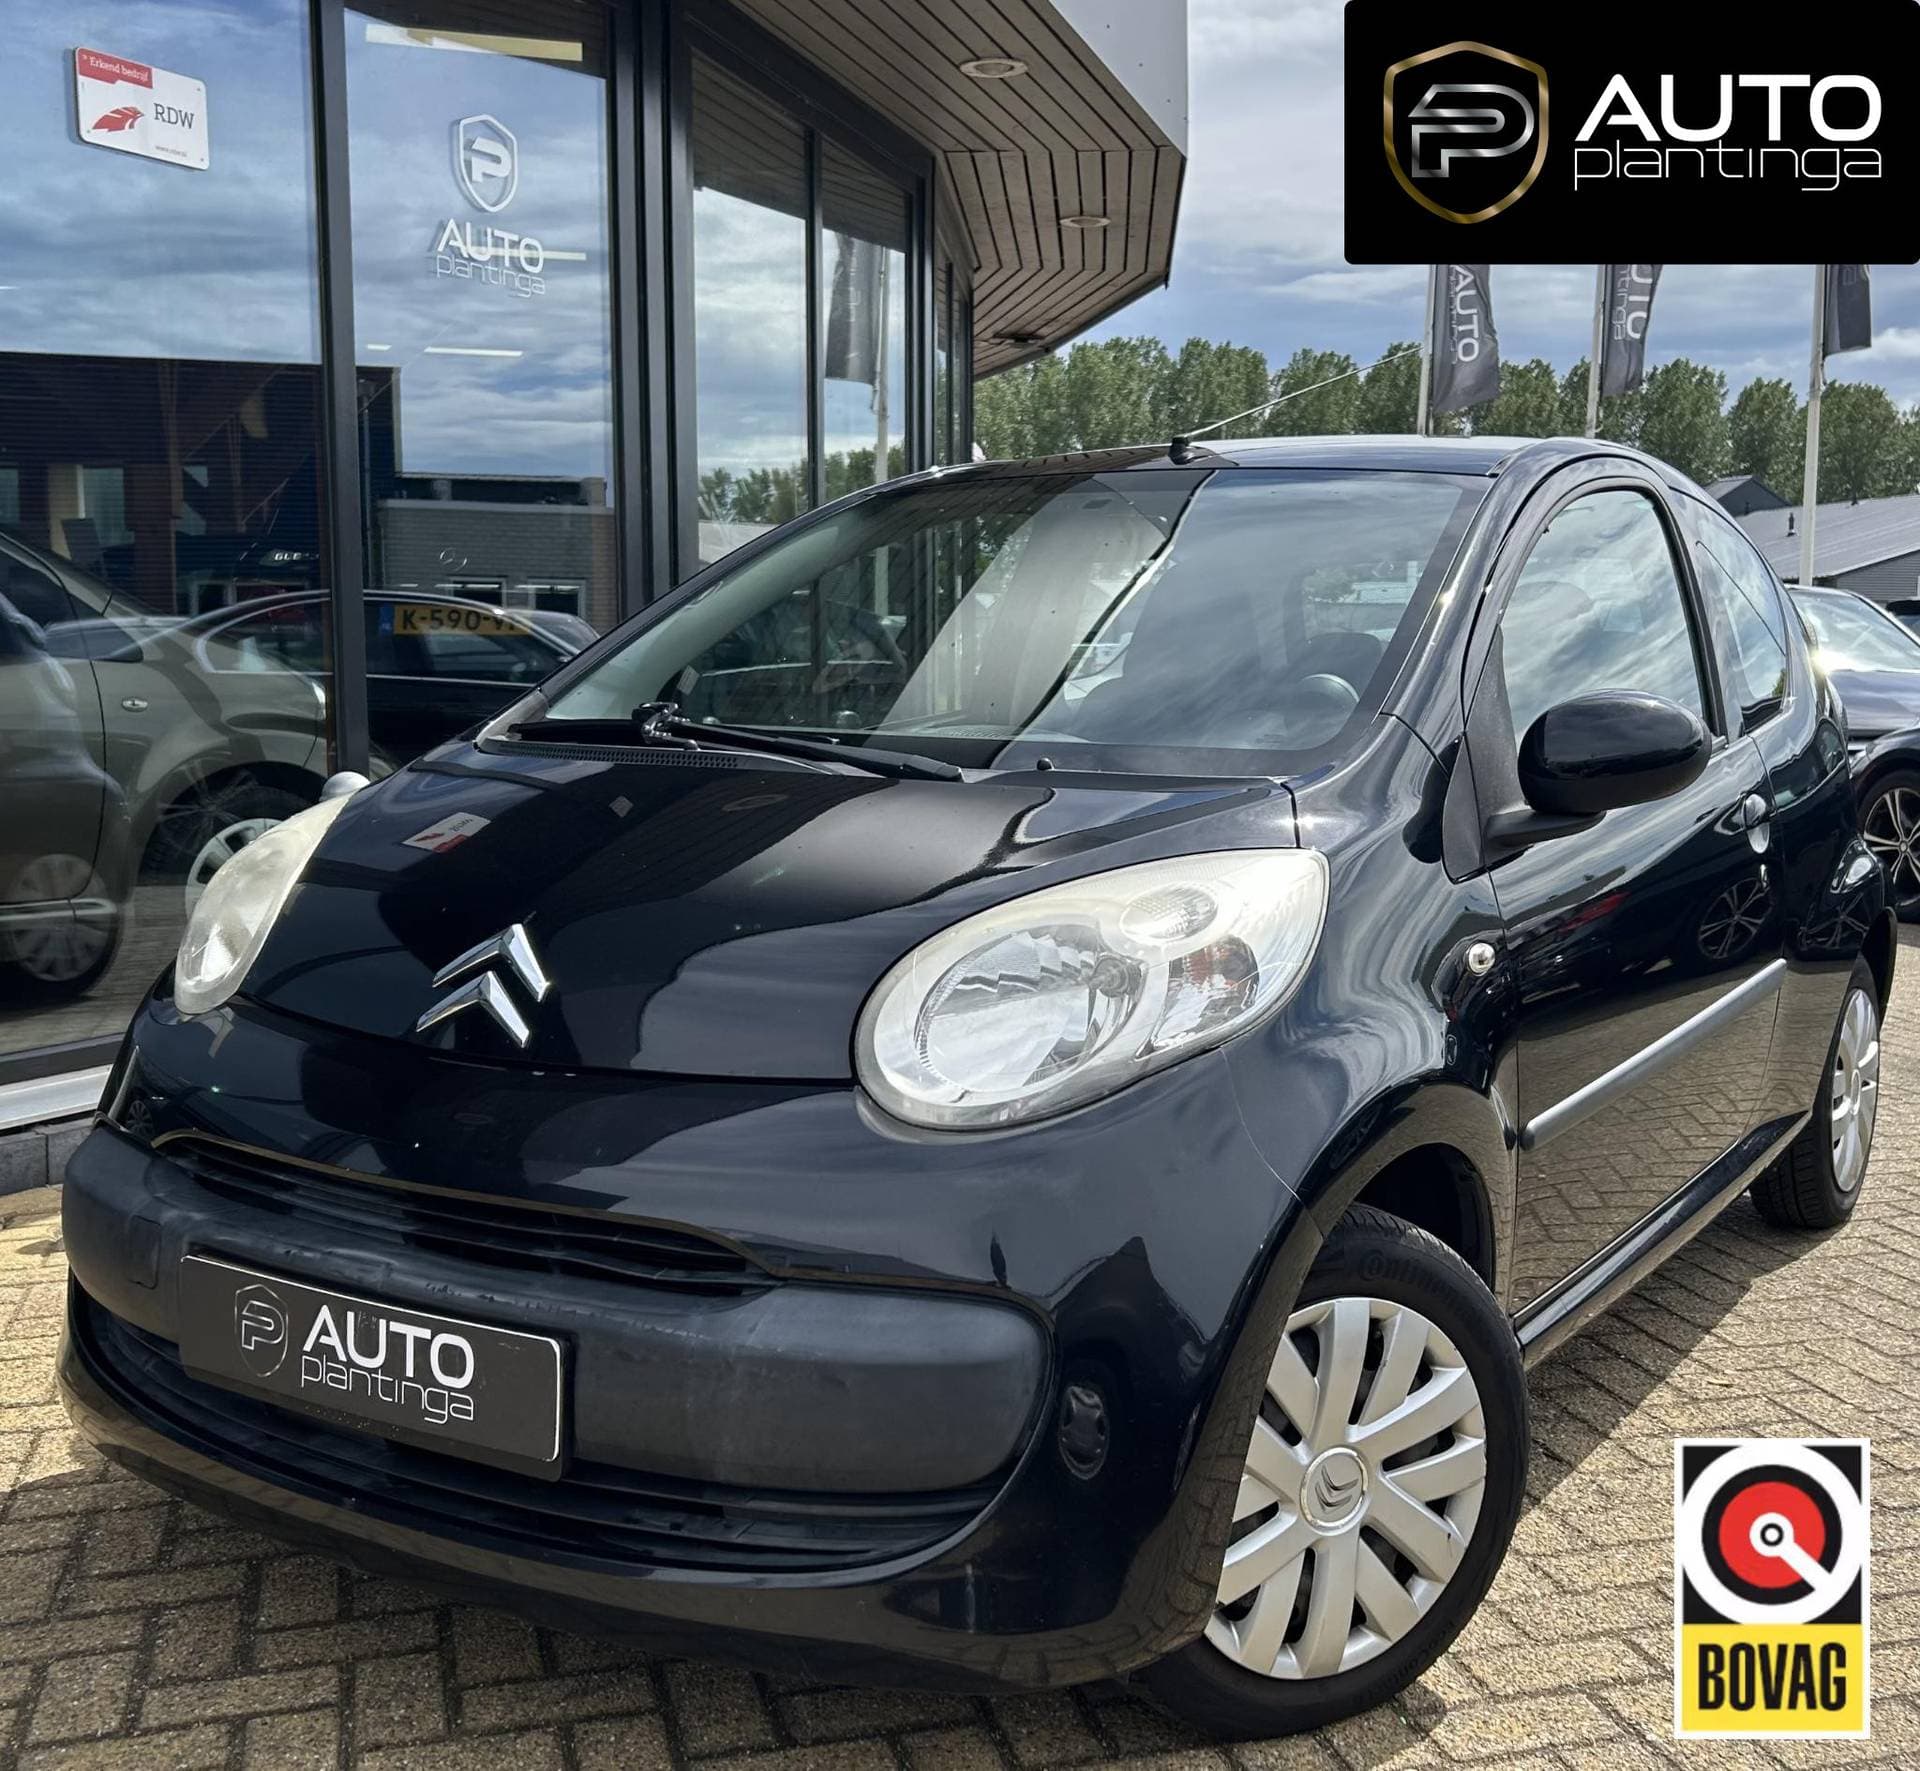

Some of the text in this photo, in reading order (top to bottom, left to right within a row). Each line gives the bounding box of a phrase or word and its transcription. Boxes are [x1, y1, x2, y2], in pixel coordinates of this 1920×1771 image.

[89, 55, 149, 82] Erkend bedrijf
[153, 102, 195, 130] RDW
[437, 217, 545, 274] AUTO
[436, 253, 546, 298] plantinga
[1454, 264, 1480, 362] AUTO
[402, 608, 517, 632] K-590-V
[302, 1303, 475, 1389] AUTO
[300, 1354, 474, 1425] plantinga
